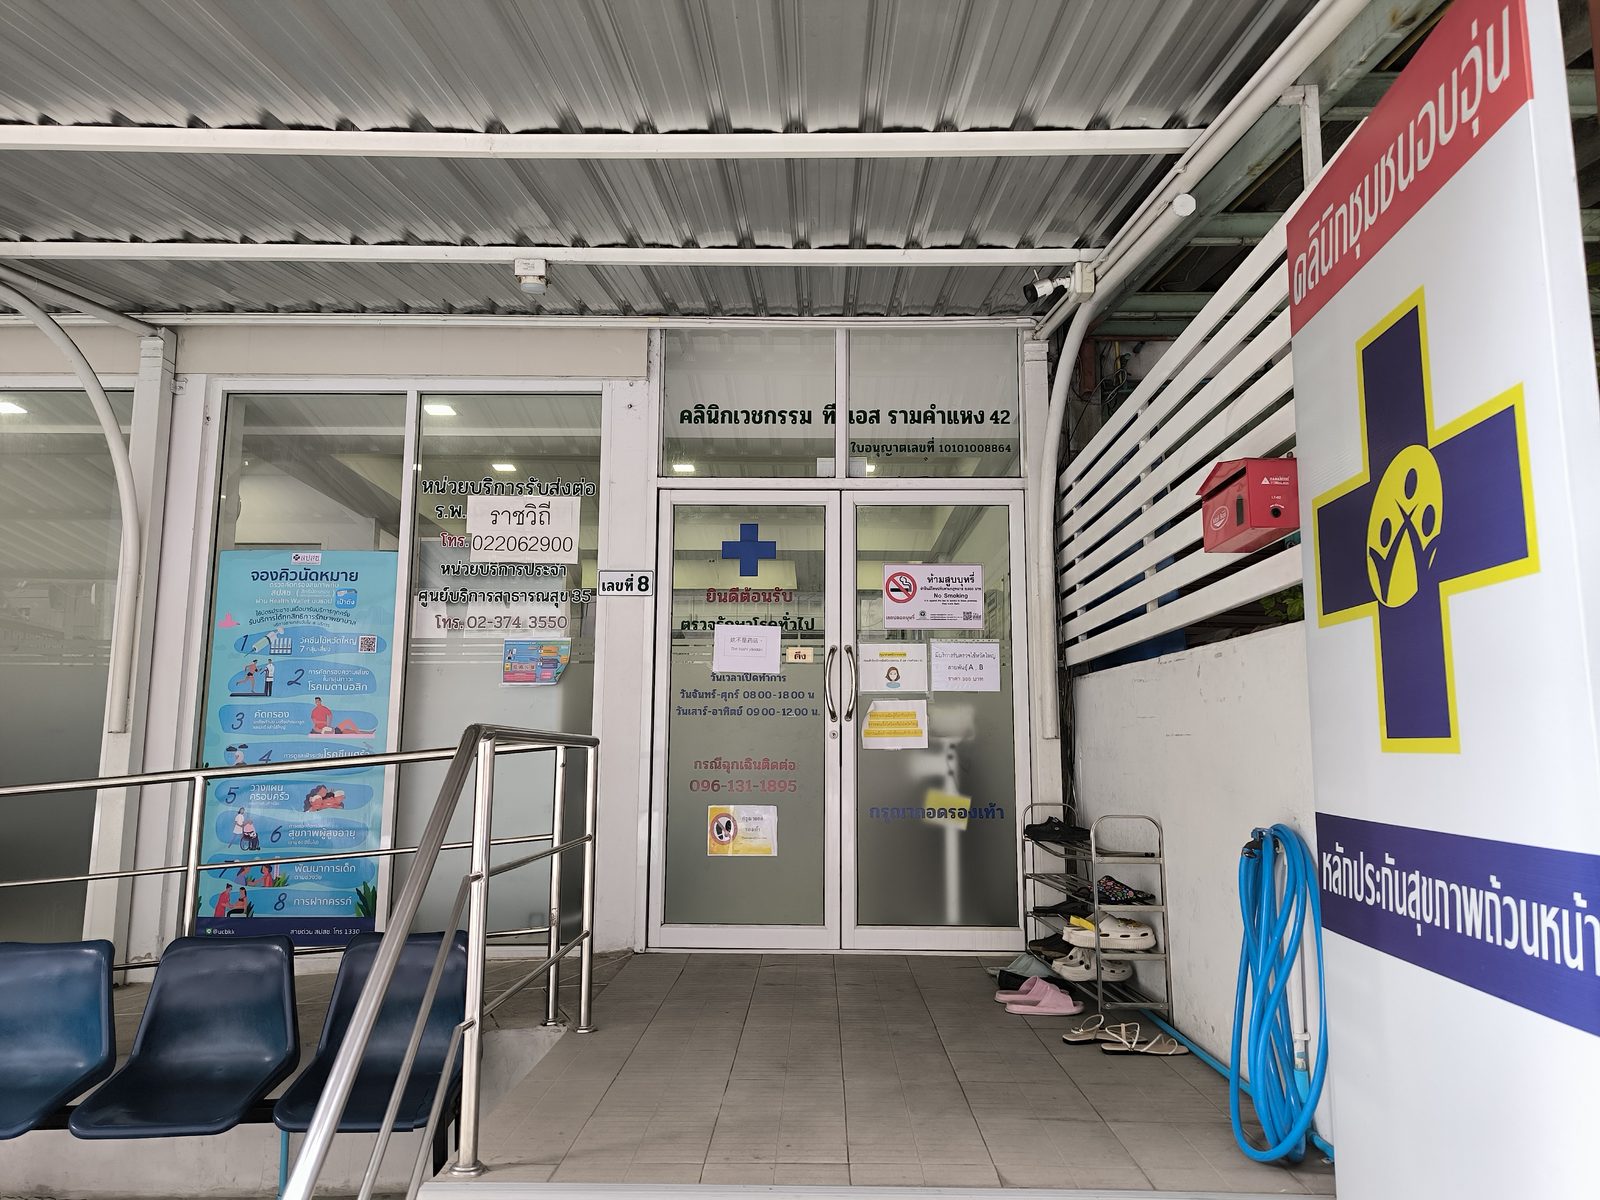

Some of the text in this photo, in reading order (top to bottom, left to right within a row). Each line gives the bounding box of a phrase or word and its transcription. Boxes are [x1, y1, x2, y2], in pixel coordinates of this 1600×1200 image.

[1293, 6, 1510, 306] คลินิกชุมชนอบอุ่น
[679, 404, 812, 425] คลินิกเวชกรรม
[888, 405, 985, 425] รามคำแหง
[989, 409, 1011, 425] 42
[850, 437, 1012, 457] ใบอนุญาตเลขที่ 10101008864
[421, 476, 596, 496] หน่วยบริการรับส่งต่อ
[435, 505, 467, 519] ร.พ.
[490, 501, 551, 526] ราชวิถี
[440, 532, 469, 547] โทร.
[472, 535, 573, 552] 022062900
[251, 567, 359, 582] จองคิวนัดหมาย
[440, 561, 567, 578] หน่วยบริการประจำ
[601, 574, 650, 592] เลขที่ 8
[926, 572, 975, 587] ห้ามสูบบุหรี่
[418, 587, 592, 608] ศูนย์บริการสาธารณสุข 35
[706, 587, 794, 603] ยินดีต้อนรับ
[466, 616, 522, 629] 02-374
[528, 616, 568, 629] 3550
[239, 634, 249, 652] 1
[287, 669, 305, 686] 2
[231, 712, 245, 730] 3
[254, 709, 290, 719] คัดกรอง
[693, 757, 796, 774] กรณีฉุกเฉินติดต่อ
[250, 784, 284, 792] วางแผน
[689, 779, 797, 793] 096-131-1895
[225, 786, 240, 804] 5
[249, 791, 290, 801] ครอบครัว
[869, 802, 1005, 823] กรุณาถอดรองเท้า
[270, 825, 283, 843] 6
[273, 892, 287, 911] 8
[1322, 841, 1600, 978] หลักประกันสุขภาพถ้วนหน้า
